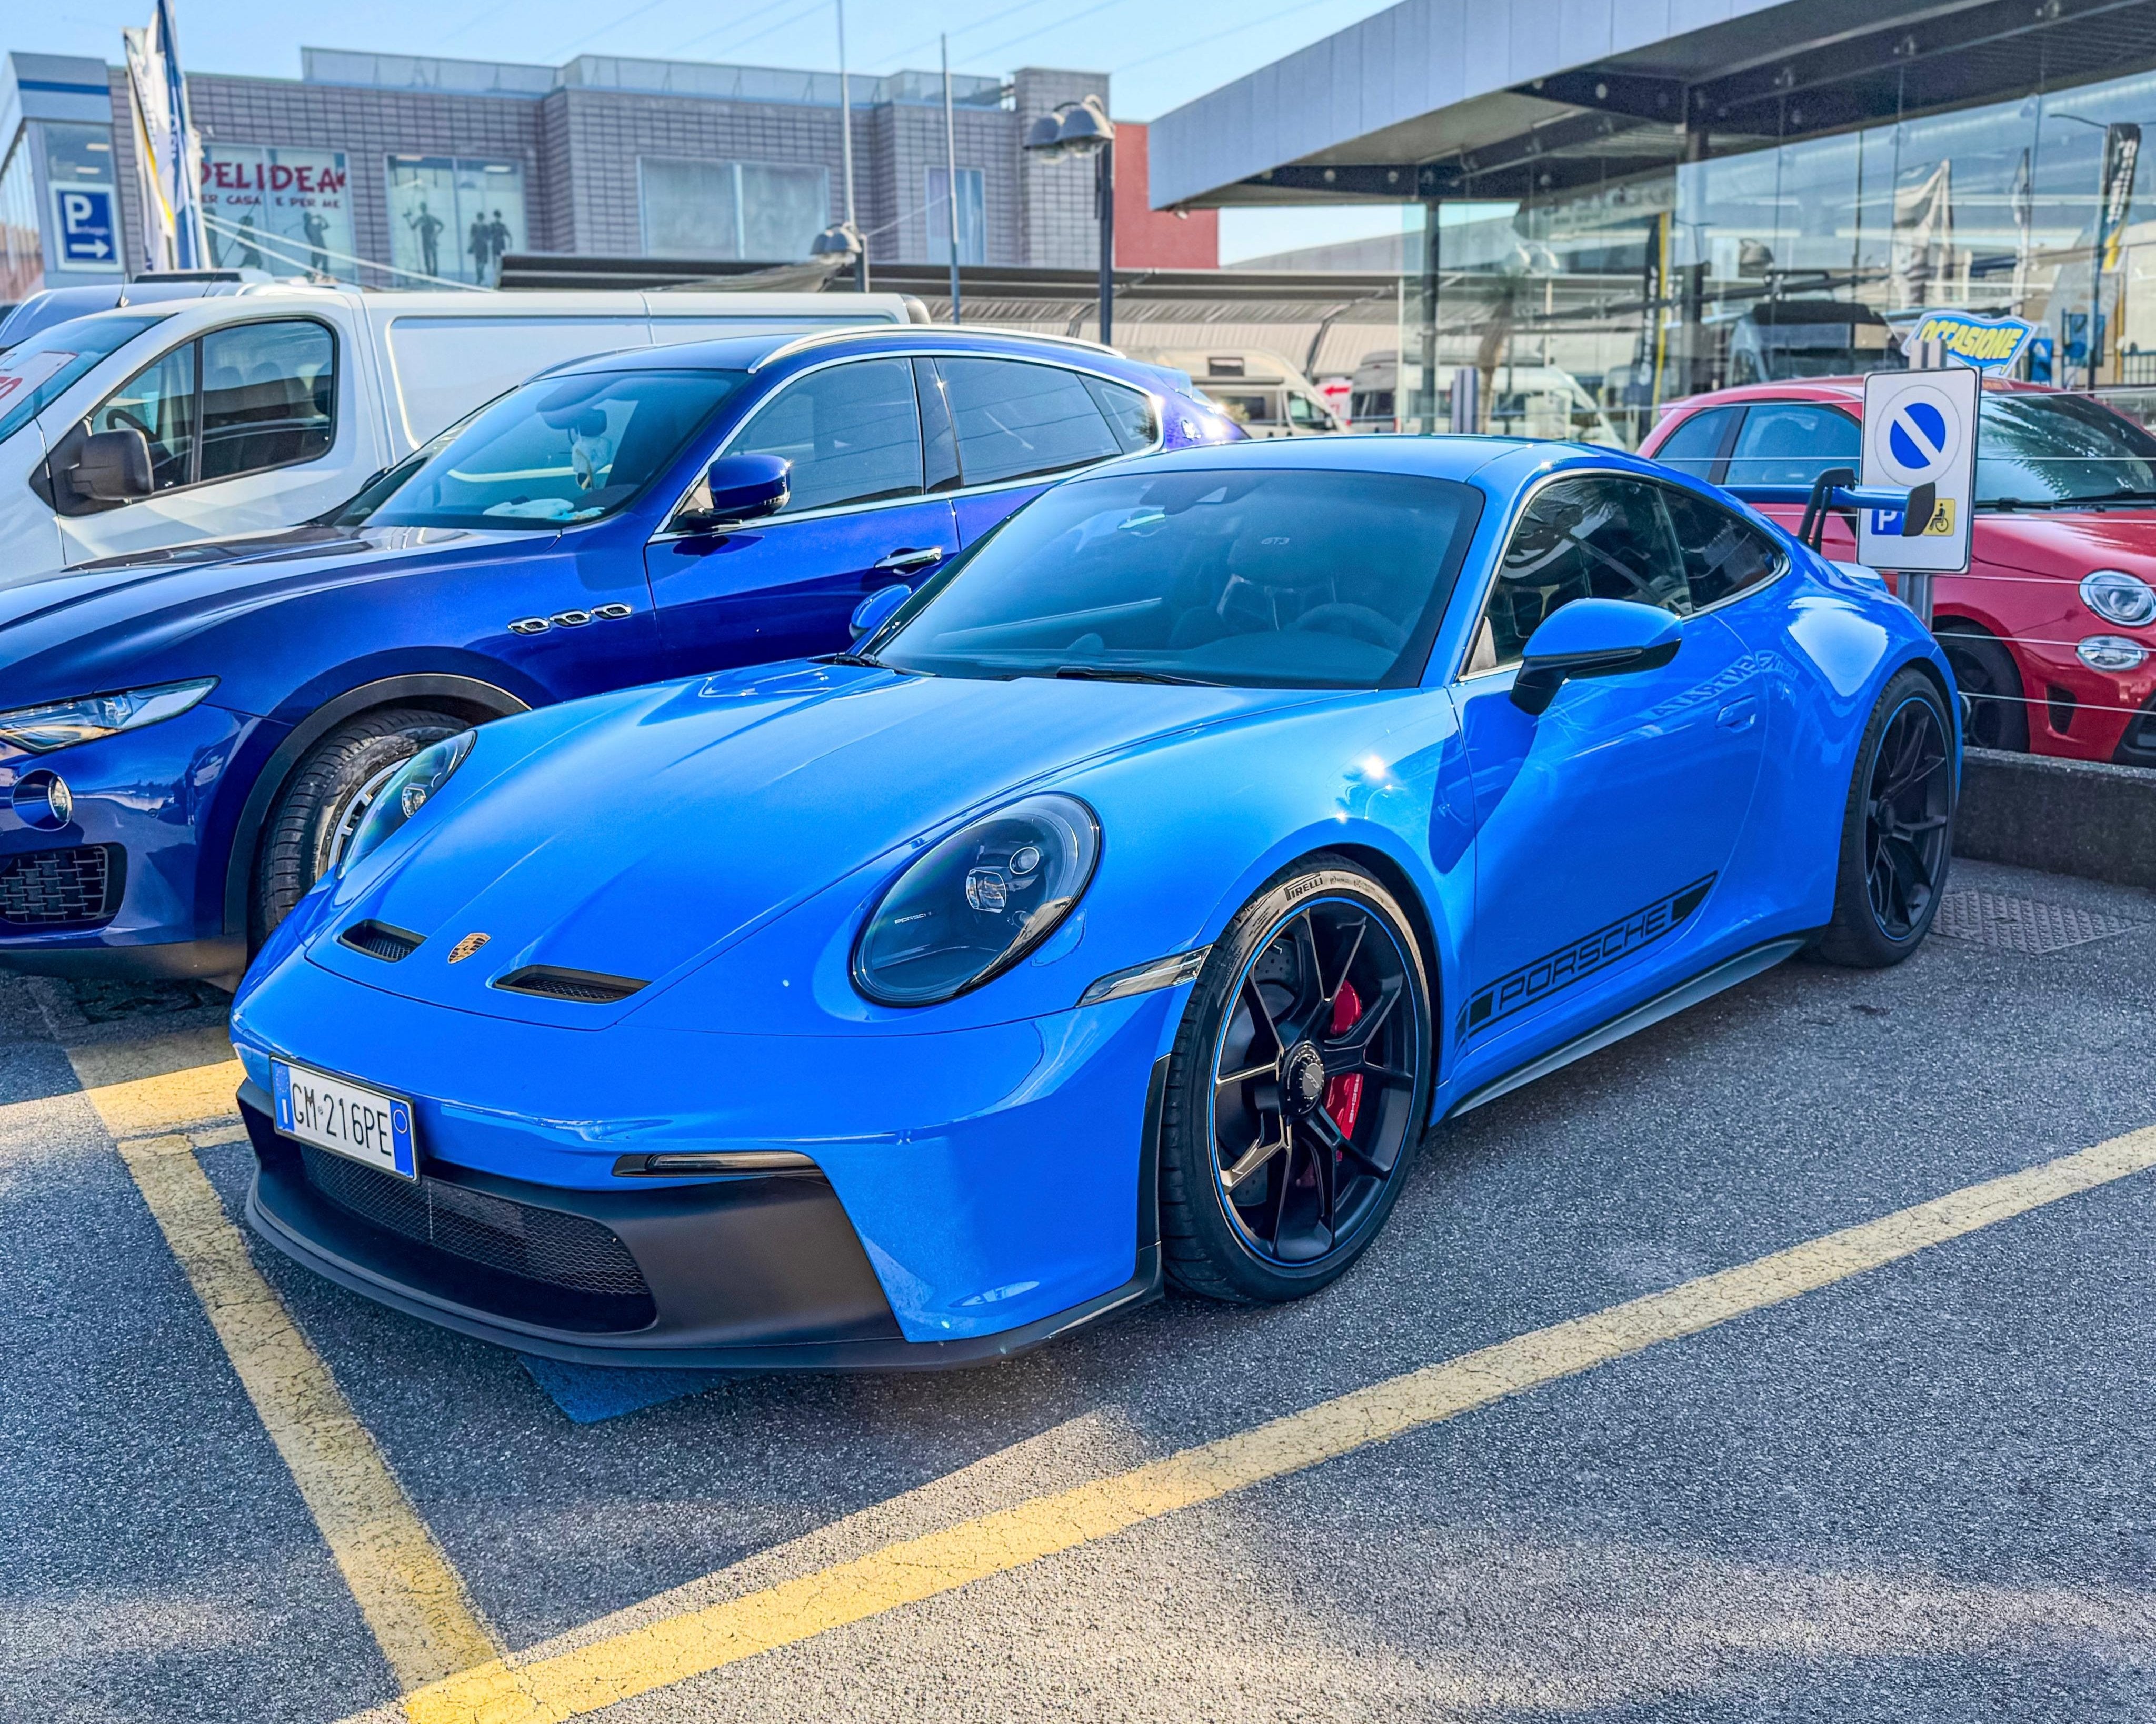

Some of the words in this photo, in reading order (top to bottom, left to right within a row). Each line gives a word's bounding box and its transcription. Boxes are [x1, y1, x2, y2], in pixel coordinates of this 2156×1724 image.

[1283, 872, 1323, 901] PIRELLI
[1499, 903, 1668, 1011] PORSCHE
[292, 1082, 318, 1131] GM
[323, 1092, 392, 1157] 216PE
